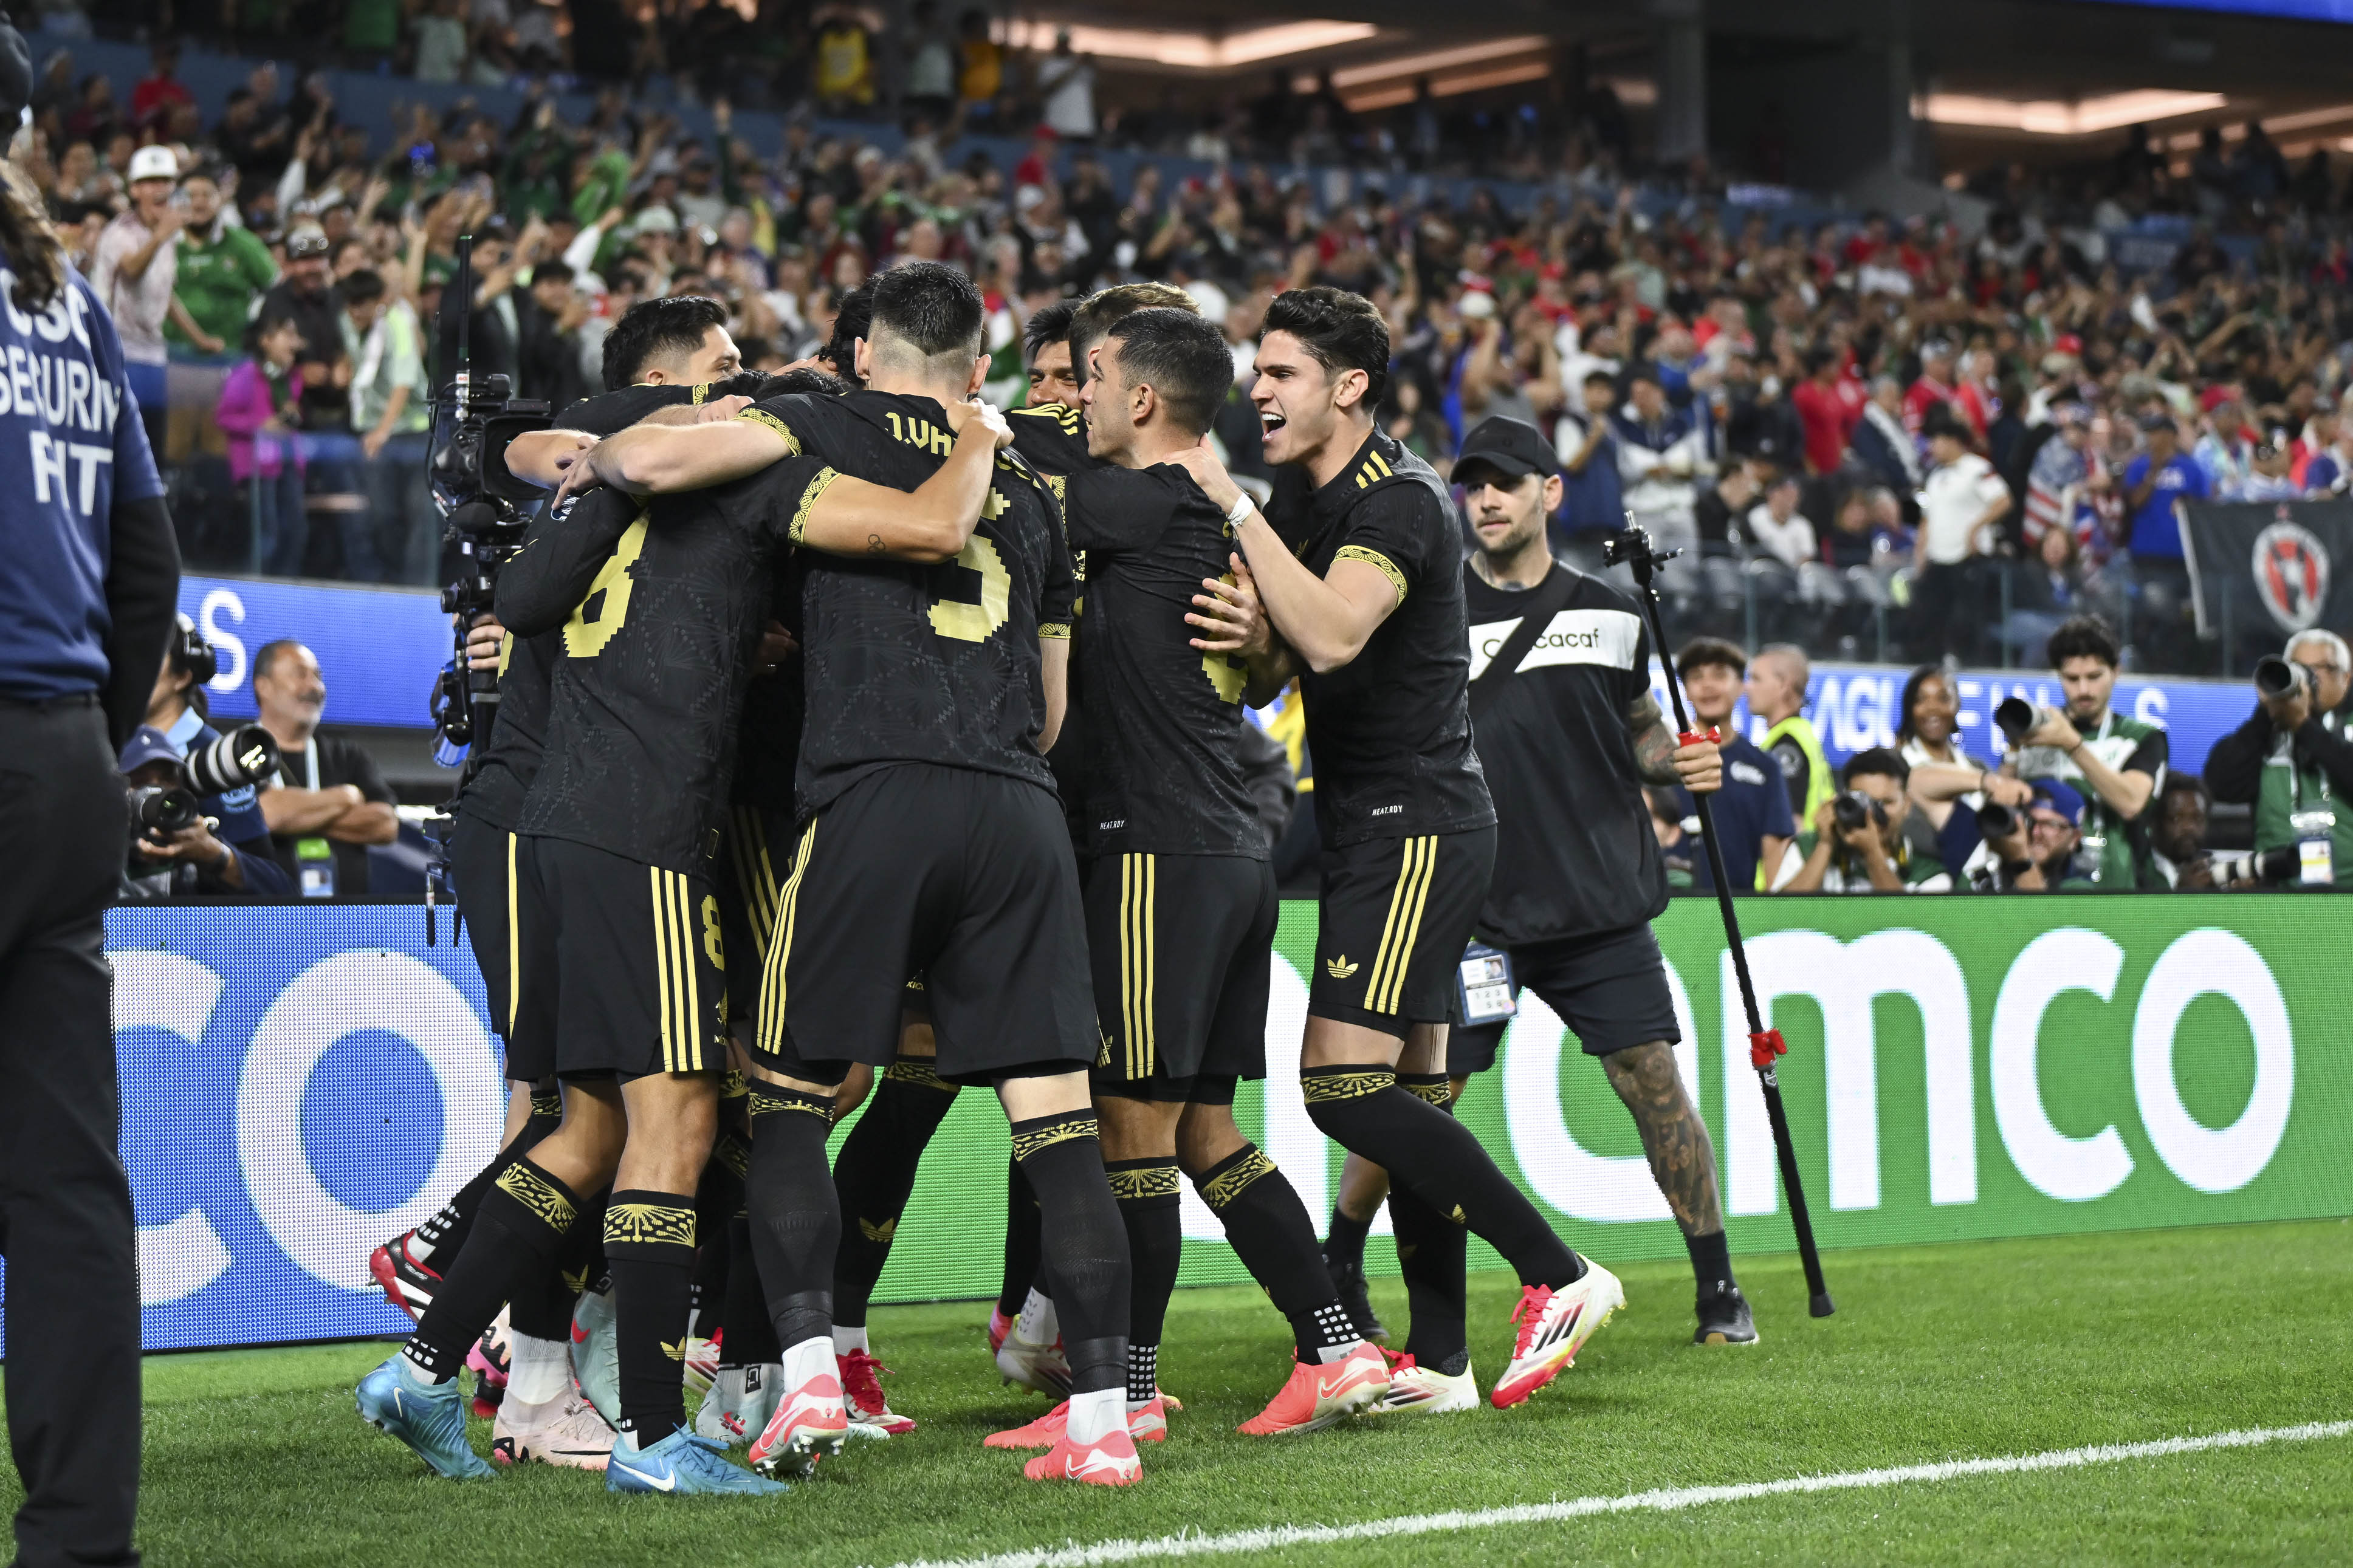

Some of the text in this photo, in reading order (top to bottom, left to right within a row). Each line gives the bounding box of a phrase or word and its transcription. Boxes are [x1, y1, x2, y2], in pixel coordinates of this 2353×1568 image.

[928, 487, 1011, 643] 5
[1483, 628, 1599, 659] Ccacaf
[1372, 805, 1403, 816] HEAT.RDY
[1100, 820, 1125, 830] HEAT.RDY
